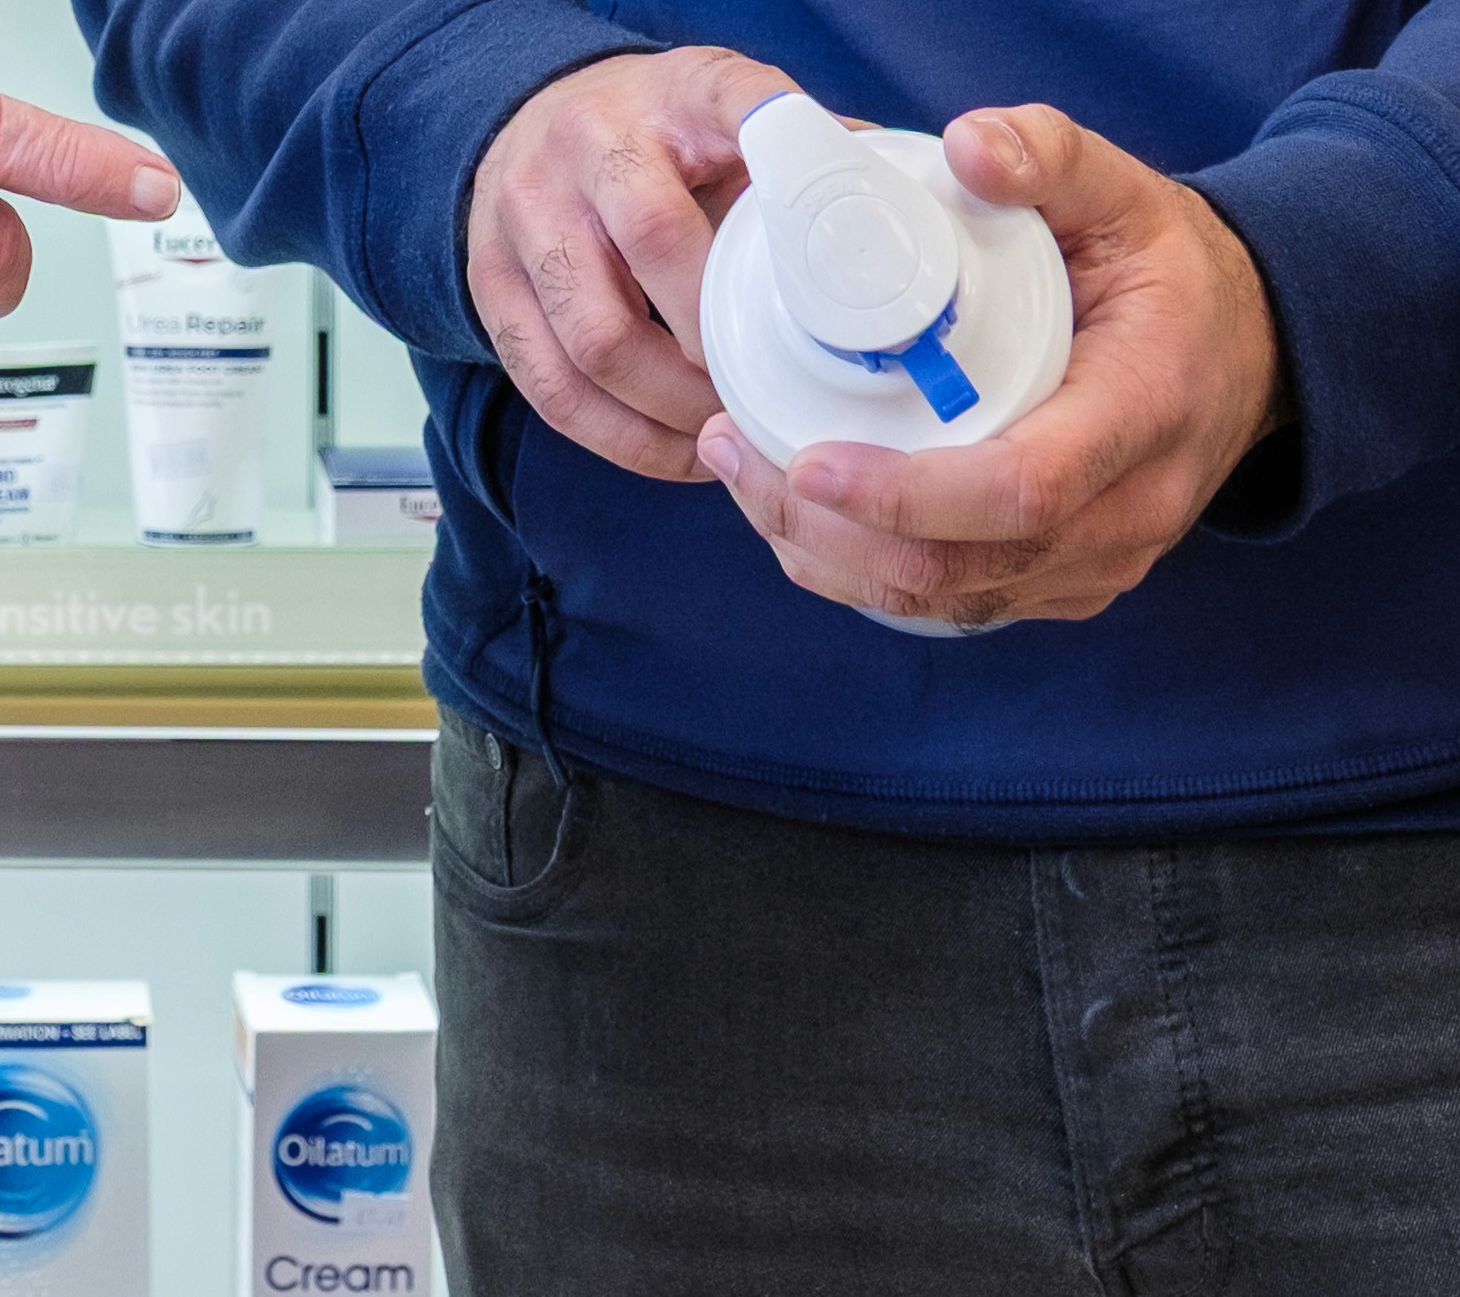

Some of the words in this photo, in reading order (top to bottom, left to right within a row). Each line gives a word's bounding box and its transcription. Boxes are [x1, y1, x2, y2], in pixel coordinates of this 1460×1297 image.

[153, 228, 215, 255] Eucer
[183, 312, 267, 337] Repair
[171, 583, 272, 638] skin
[277, 1133, 411, 1168] Oilatum
[264, 1255, 415, 1293] Cream
